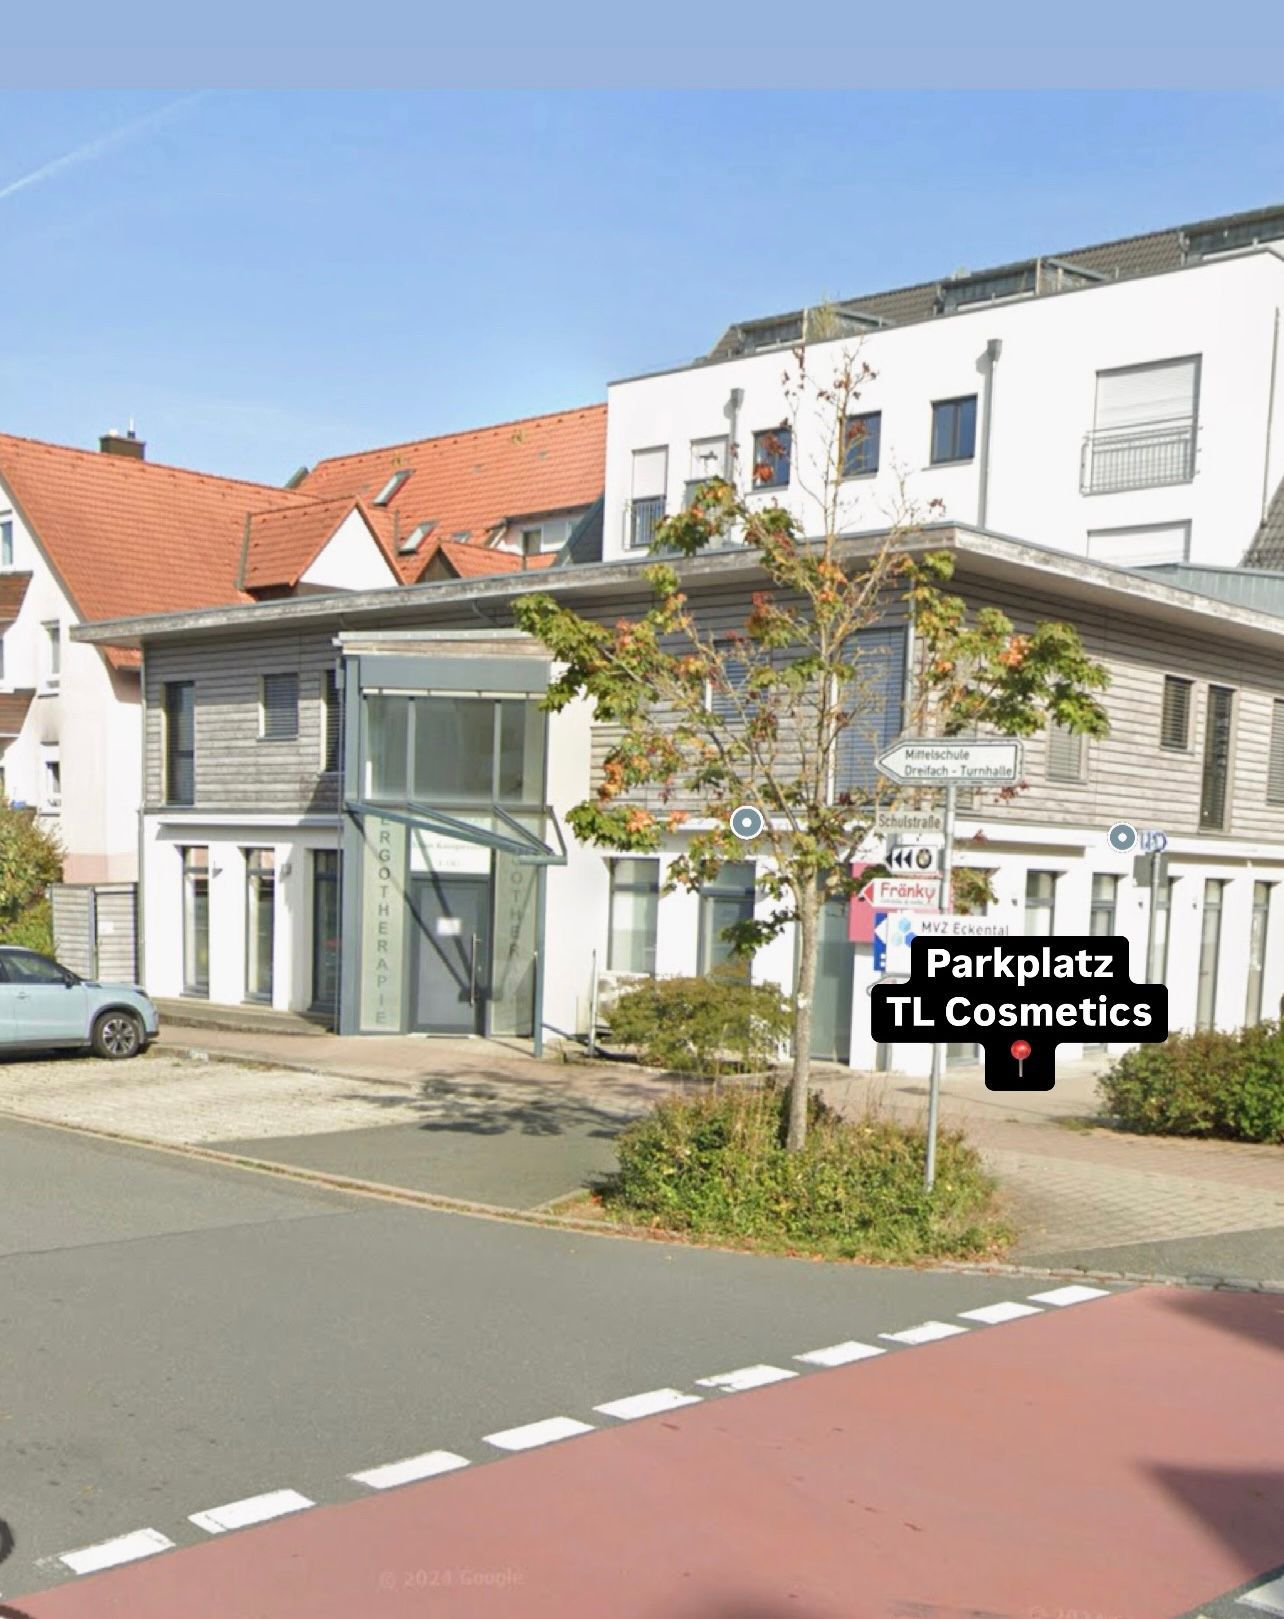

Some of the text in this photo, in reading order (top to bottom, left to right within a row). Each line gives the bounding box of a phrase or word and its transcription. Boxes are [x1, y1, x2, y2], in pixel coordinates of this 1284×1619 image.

[904, 749, 970, 761] Mittelschule
[903, 764, 949, 777] Dreifach
[960, 764, 1013, 777] Turnhalle
[878, 813, 942, 829] Schulstraße
[880, 881, 937, 904] Fränky
[921, 920, 1010, 937] MVZ Eckental
